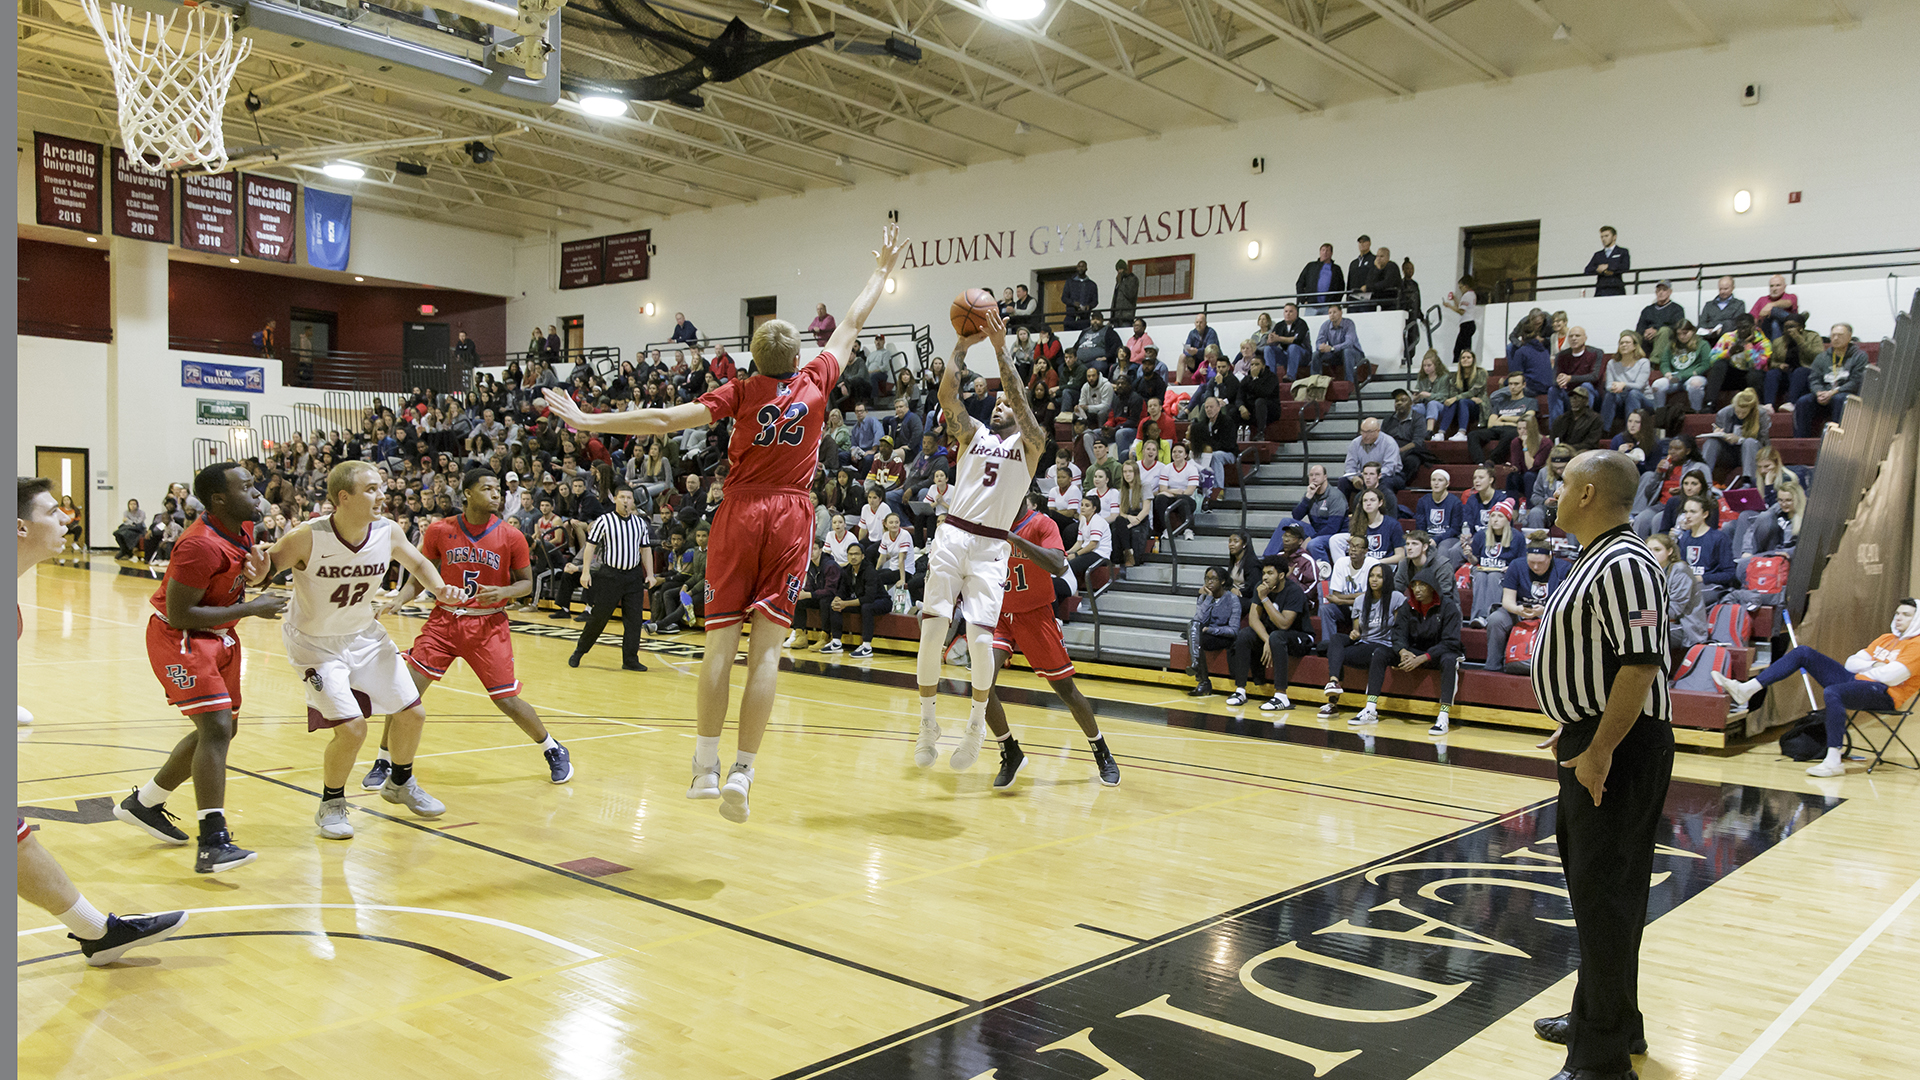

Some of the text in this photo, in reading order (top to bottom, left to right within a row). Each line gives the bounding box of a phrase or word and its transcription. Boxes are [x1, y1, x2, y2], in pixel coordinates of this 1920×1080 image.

[43, 142, 95, 165] Arcadia
[43, 157, 95, 178] University
[43, 175, 95, 191] Women's Soccer
[118, 171, 167, 190] University
[186, 175, 233, 192] Arcadia
[53, 186, 87, 199] ECAC South
[186, 184, 233, 204] University
[248, 181, 292, 203] Arcadia
[53, 197, 86, 209] Champions
[248, 195, 292, 215] University
[58, 209, 82, 224] 2015
[131, 222, 155, 236] 2016
[901, 200, 1249, 269] ALUMNI GYMNASIUM
[198, 233, 222, 247] 2016
[259, 242, 281, 256] 2017
[204, 376, 245, 386] CHAMPIONS
[197, 418, 250, 427] CHAMPIONS
[752, 401, 809, 447] 32
[969, 444, 1022, 462] ARCADIA
[982, 461, 1000, 487] 5
[446, 546, 501, 570] DESALES
[316, 562, 385, 579] ARCADIA
[463, 570, 480, 599] 5
[330, 582, 370, 609] 42
